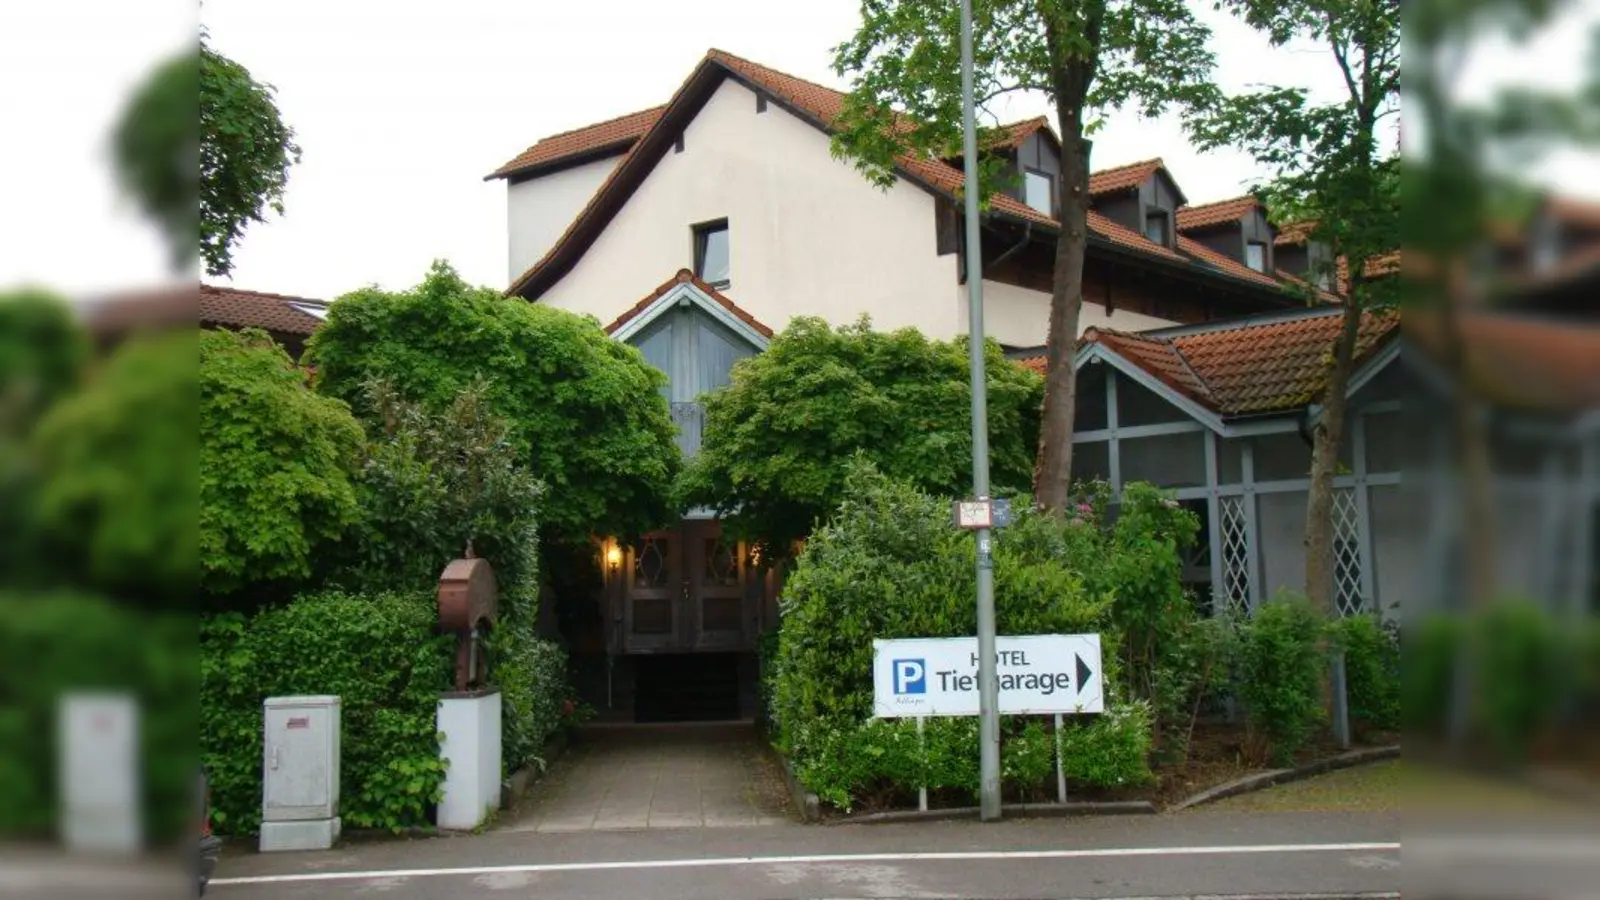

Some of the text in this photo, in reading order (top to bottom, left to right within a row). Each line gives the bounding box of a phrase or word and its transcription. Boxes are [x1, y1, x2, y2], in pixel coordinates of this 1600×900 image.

[970, 650, 1030, 667] HTEL
[897, 661, 923, 693] P
[936, 669, 1069, 695] Tiefarage
